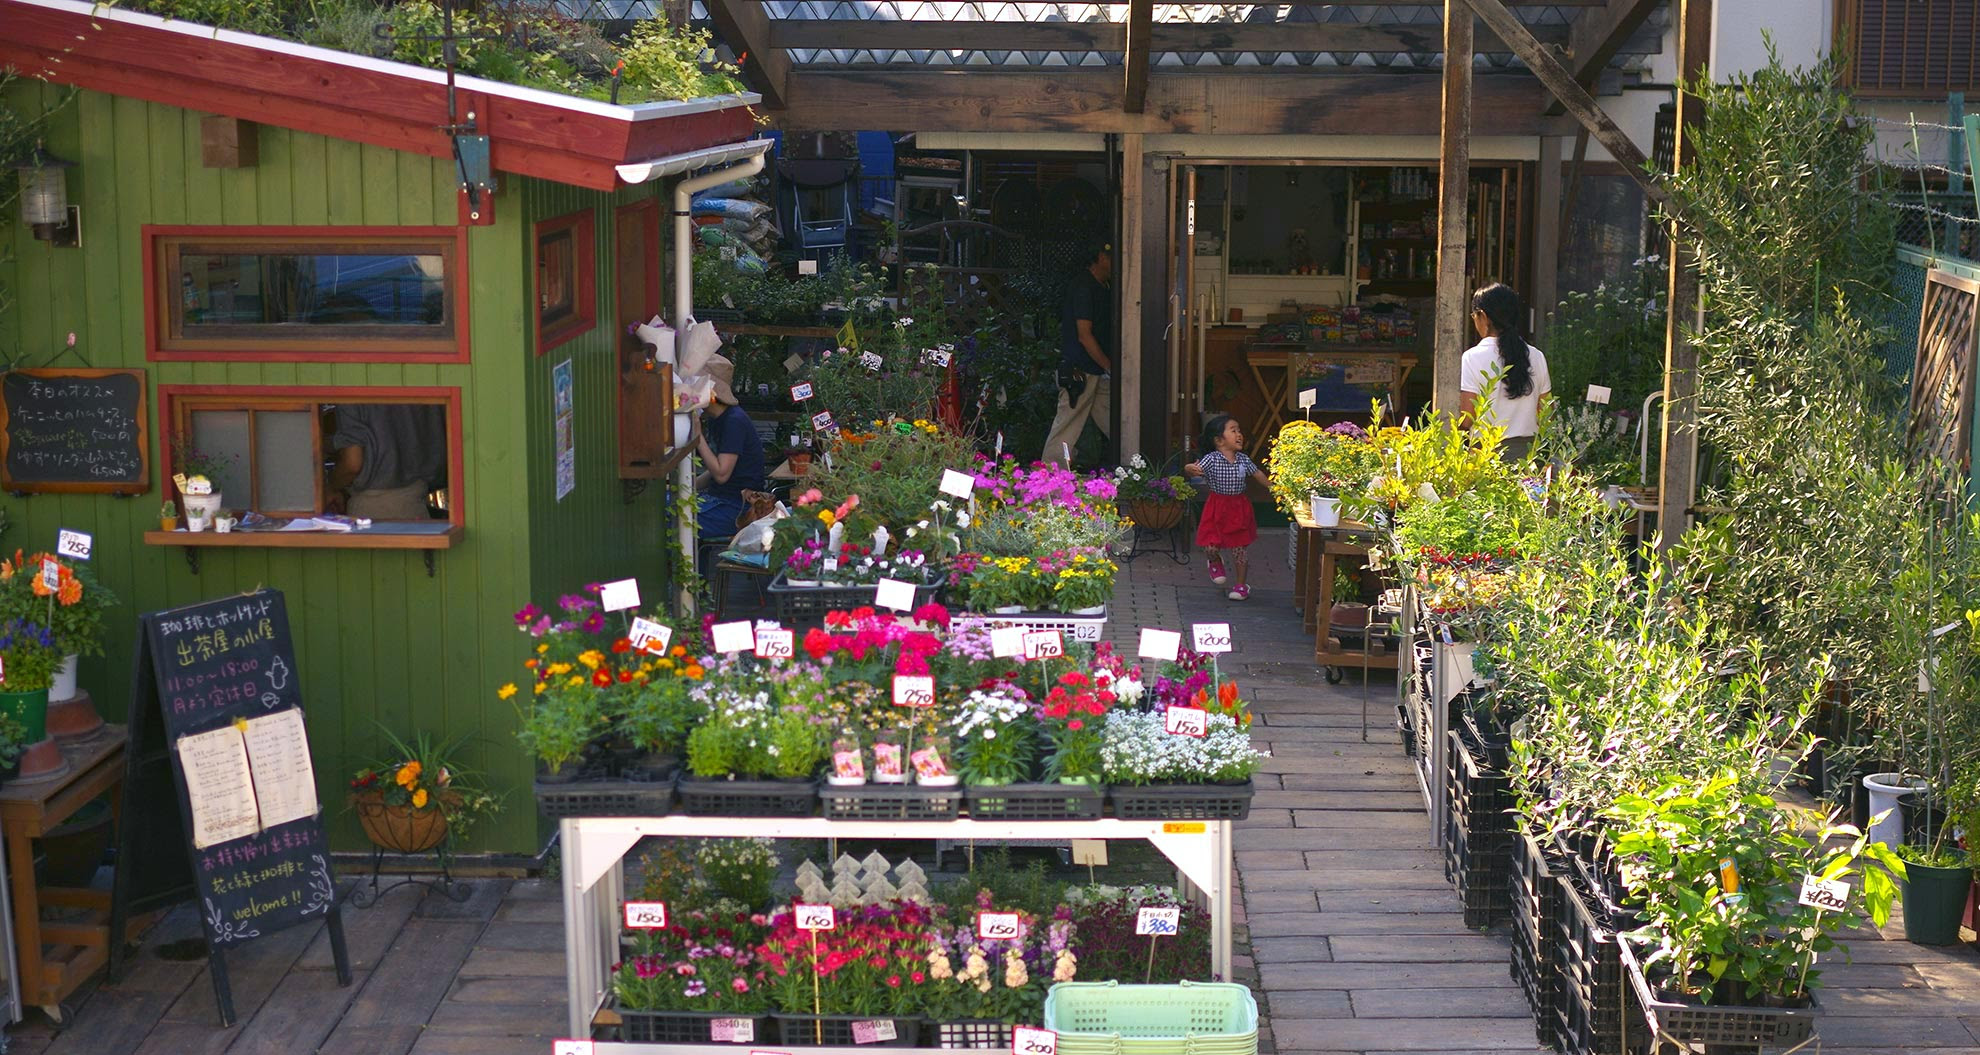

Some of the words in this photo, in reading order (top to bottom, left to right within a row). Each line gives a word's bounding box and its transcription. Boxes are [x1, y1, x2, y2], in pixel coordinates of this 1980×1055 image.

[160, 600, 273, 636] 珈琲とホットサンド
[1077, 626, 1096, 639] 02
[176, 618, 275, 666] 出茶屋の小屋
[173, 682, 258, 714] 月よう定休日
[1805, 890, 1846, 909] ¥1200
